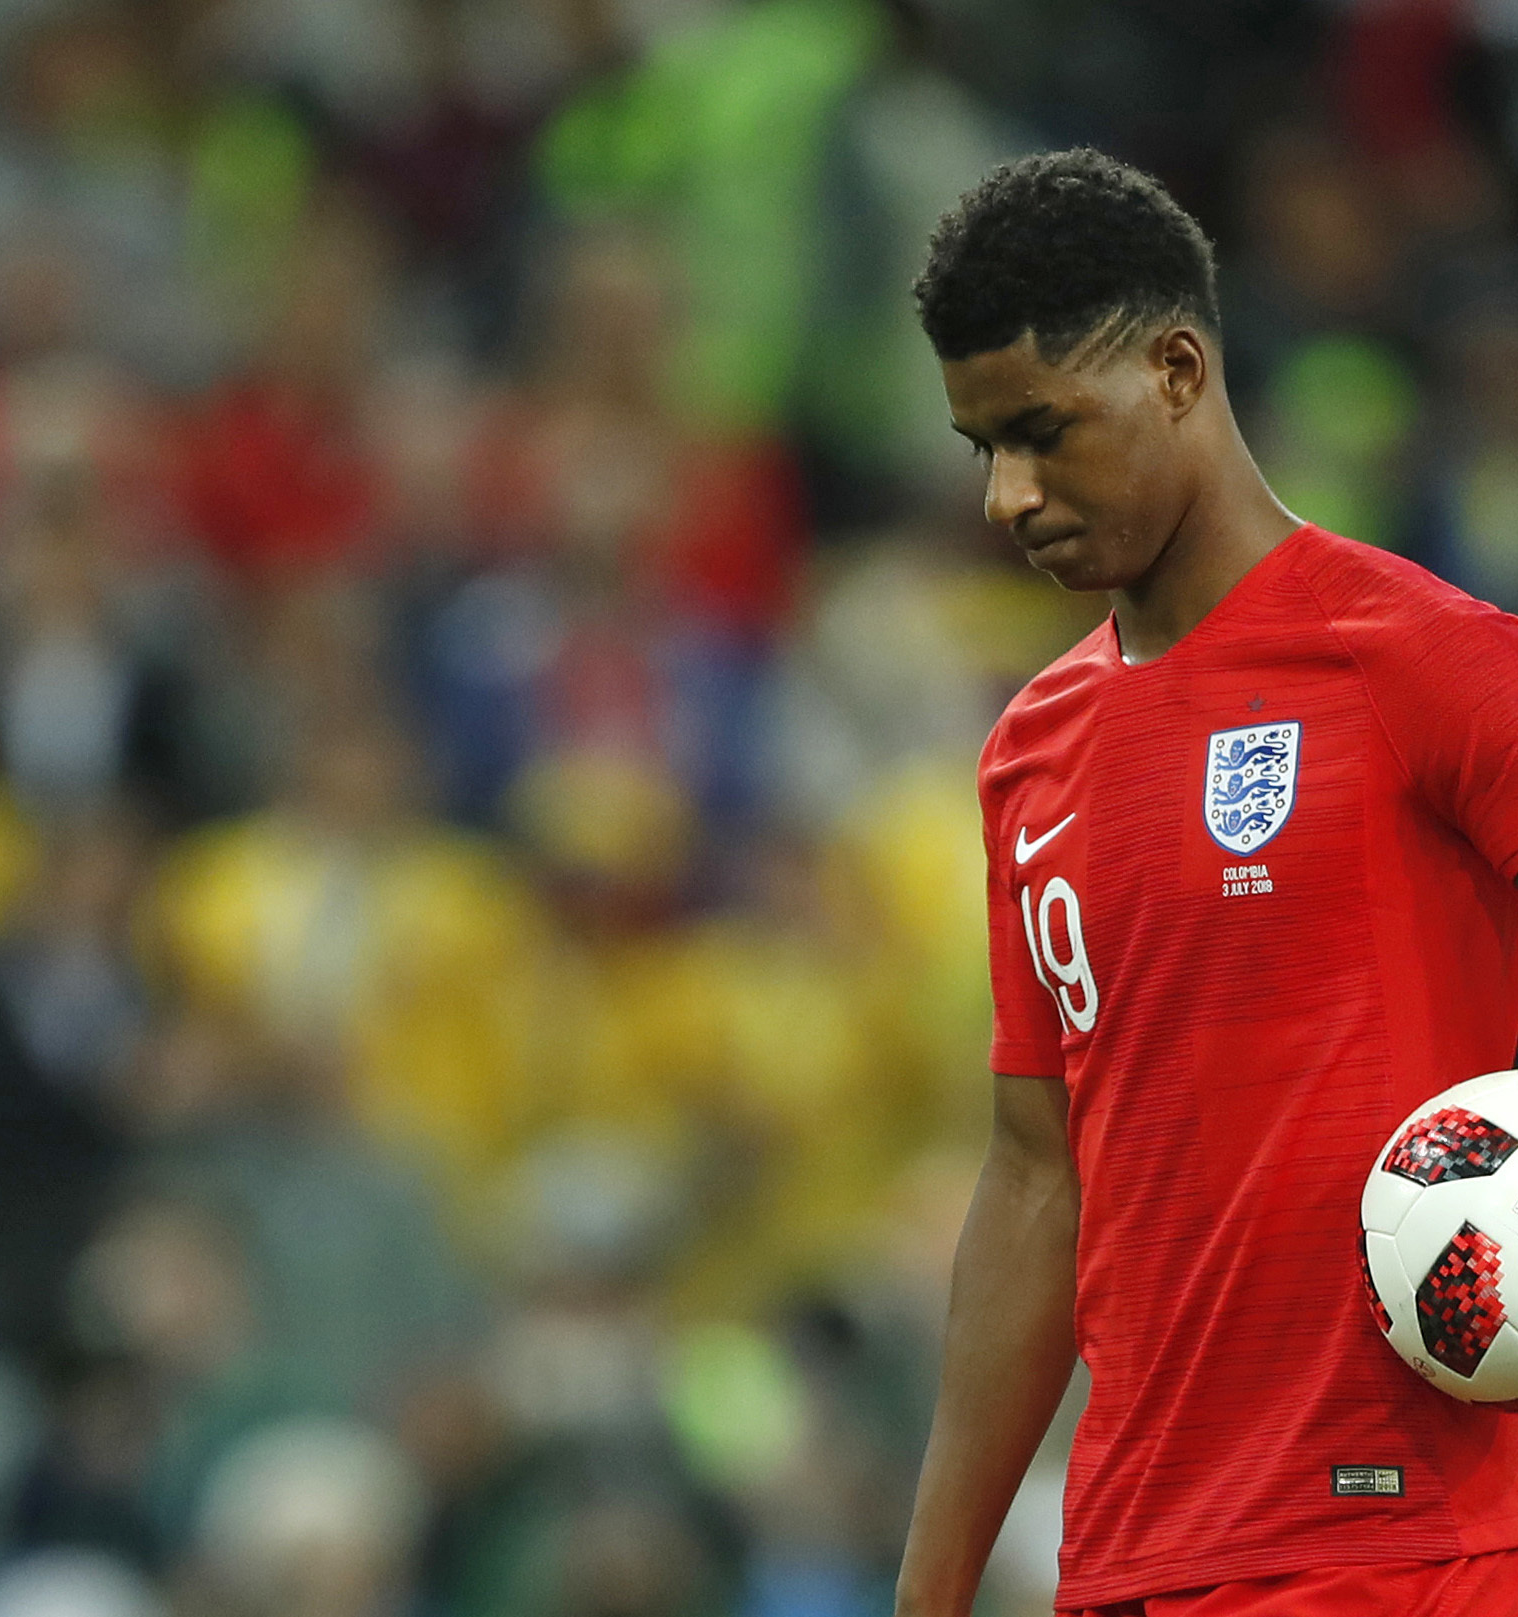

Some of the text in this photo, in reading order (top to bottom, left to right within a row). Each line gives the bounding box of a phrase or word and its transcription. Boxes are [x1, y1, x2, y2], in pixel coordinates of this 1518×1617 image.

[1223, 864, 1268, 881] COLOMBIA
[1221, 880, 1273, 897] 3 JULY 2018
[1020, 876, 1099, 1036] 19
